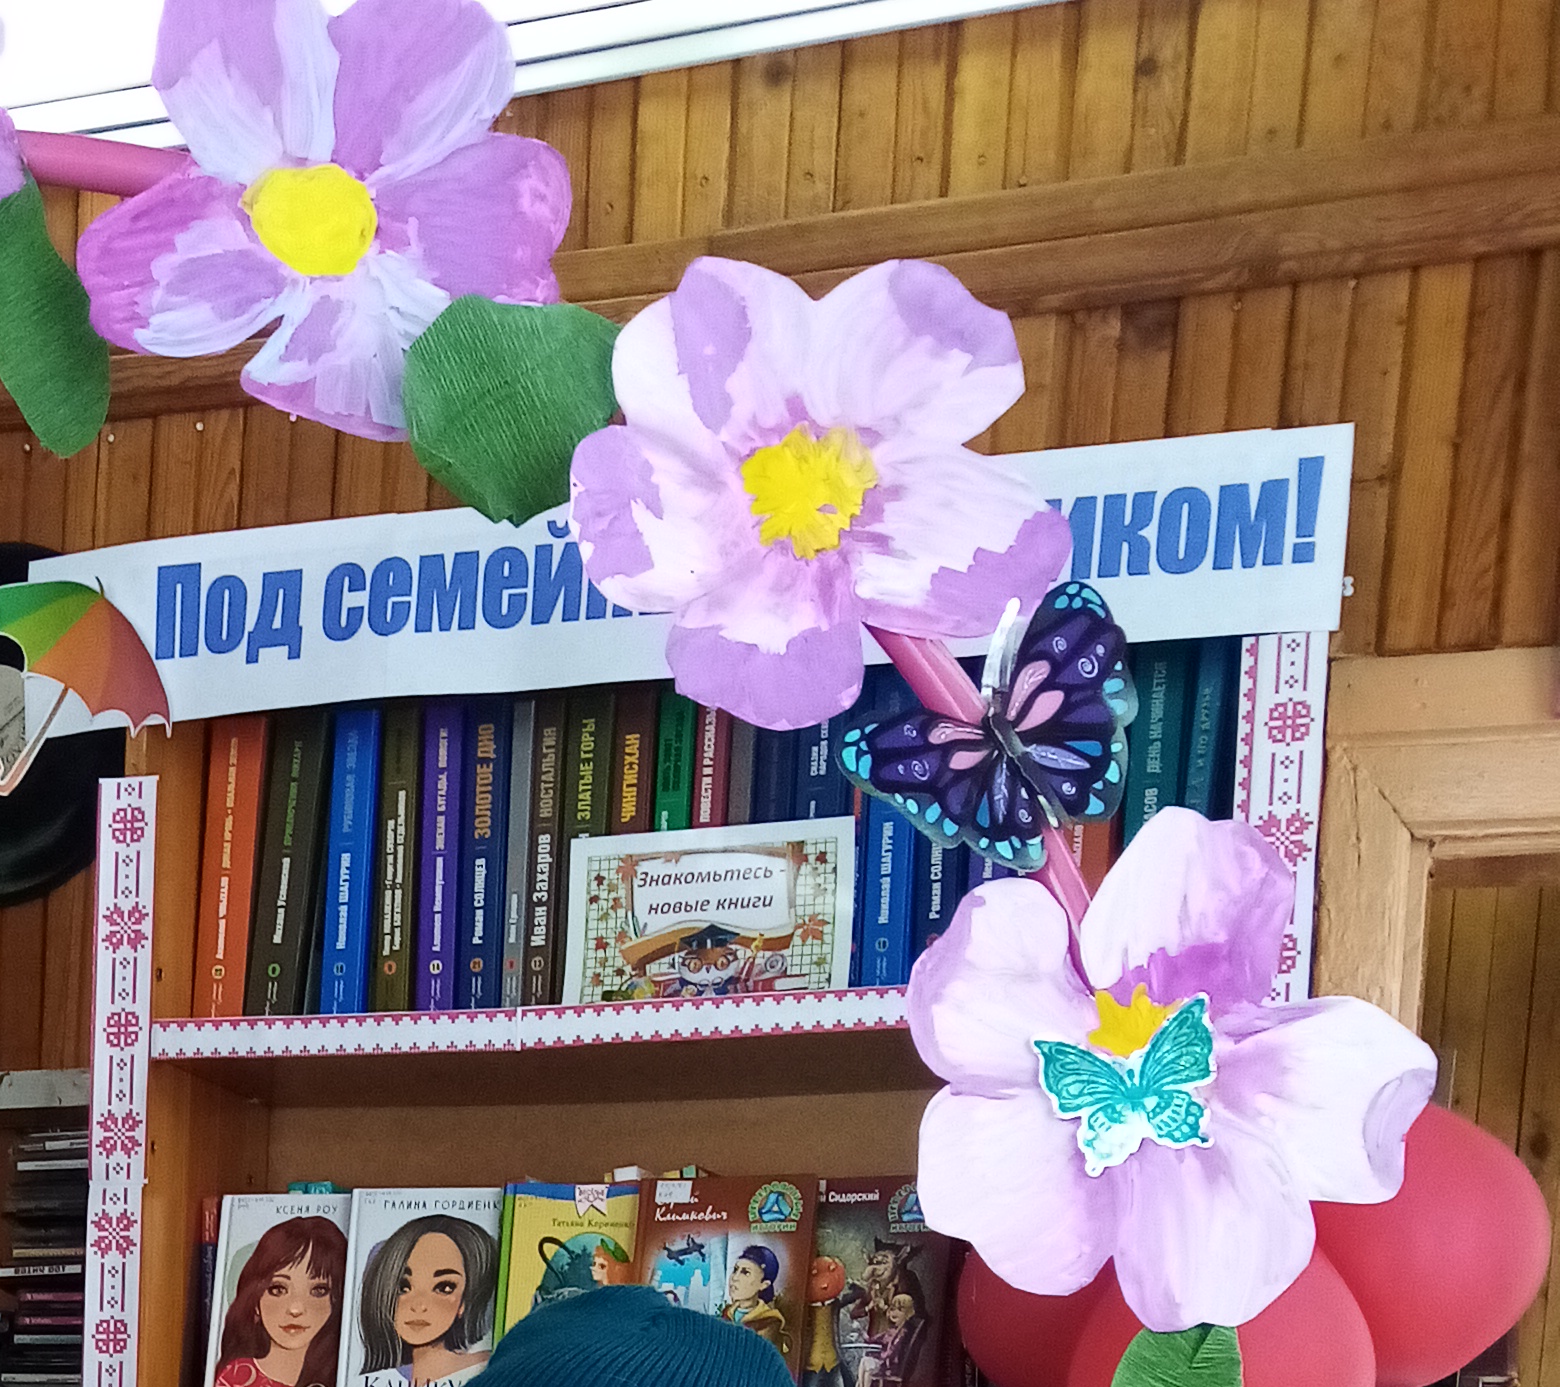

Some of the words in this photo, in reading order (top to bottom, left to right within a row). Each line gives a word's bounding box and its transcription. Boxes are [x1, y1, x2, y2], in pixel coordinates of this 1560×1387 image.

[155, 561, 303, 664] Под
[322, 520, 655, 643] семей
[1046, 456, 1325, 581] иком!
[1148, 661, 1168, 739] НАЧИНАЕТСЯ
[477, 723, 497, 759] ДНО
[580, 718, 596, 759] ГОРЫ
[1145, 741, 1164, 774] ДЕНЬ
[538, 727, 557, 818] НОСТАЛЬГИЯ
[577, 761, 593, 820] ЗЛАТЫЕ
[621, 733, 640, 823] ЧИНГИСХАН
[701, 767, 713, 775] И
[474, 763, 494, 839] ЗОЛОТОЕ
[699, 777, 712, 823] ПОВЕСТИ
[1144, 788, 1159, 824] АСОВ
[532, 833, 552, 902] Захаров
[880, 821, 894, 875] ШАГУРИН
[930, 843, 943, 880] СОЛНЦ
[474, 857, 487, 907] СОЛНЦЕВ
[637, 866, 773, 888] Знакомьтесь
[648, 899, 710, 915] новые
[716, 895, 773, 910] книги
[928, 881, 942, 920] Роман
[472, 909, 485, 944] Роман
[530, 905, 548, 947] Иван
[276, 1204, 310, 1215] КСЕНЯ
[316, 1204, 338, 1214] РОУ
[384, 1199, 427, 1210] ГАЛИНА
[435, 1199, 500, 1210] ГОРДИЕНК
[655, 1206, 728, 1222] Климкович
[828, 1189, 880, 1203] Сидорский
